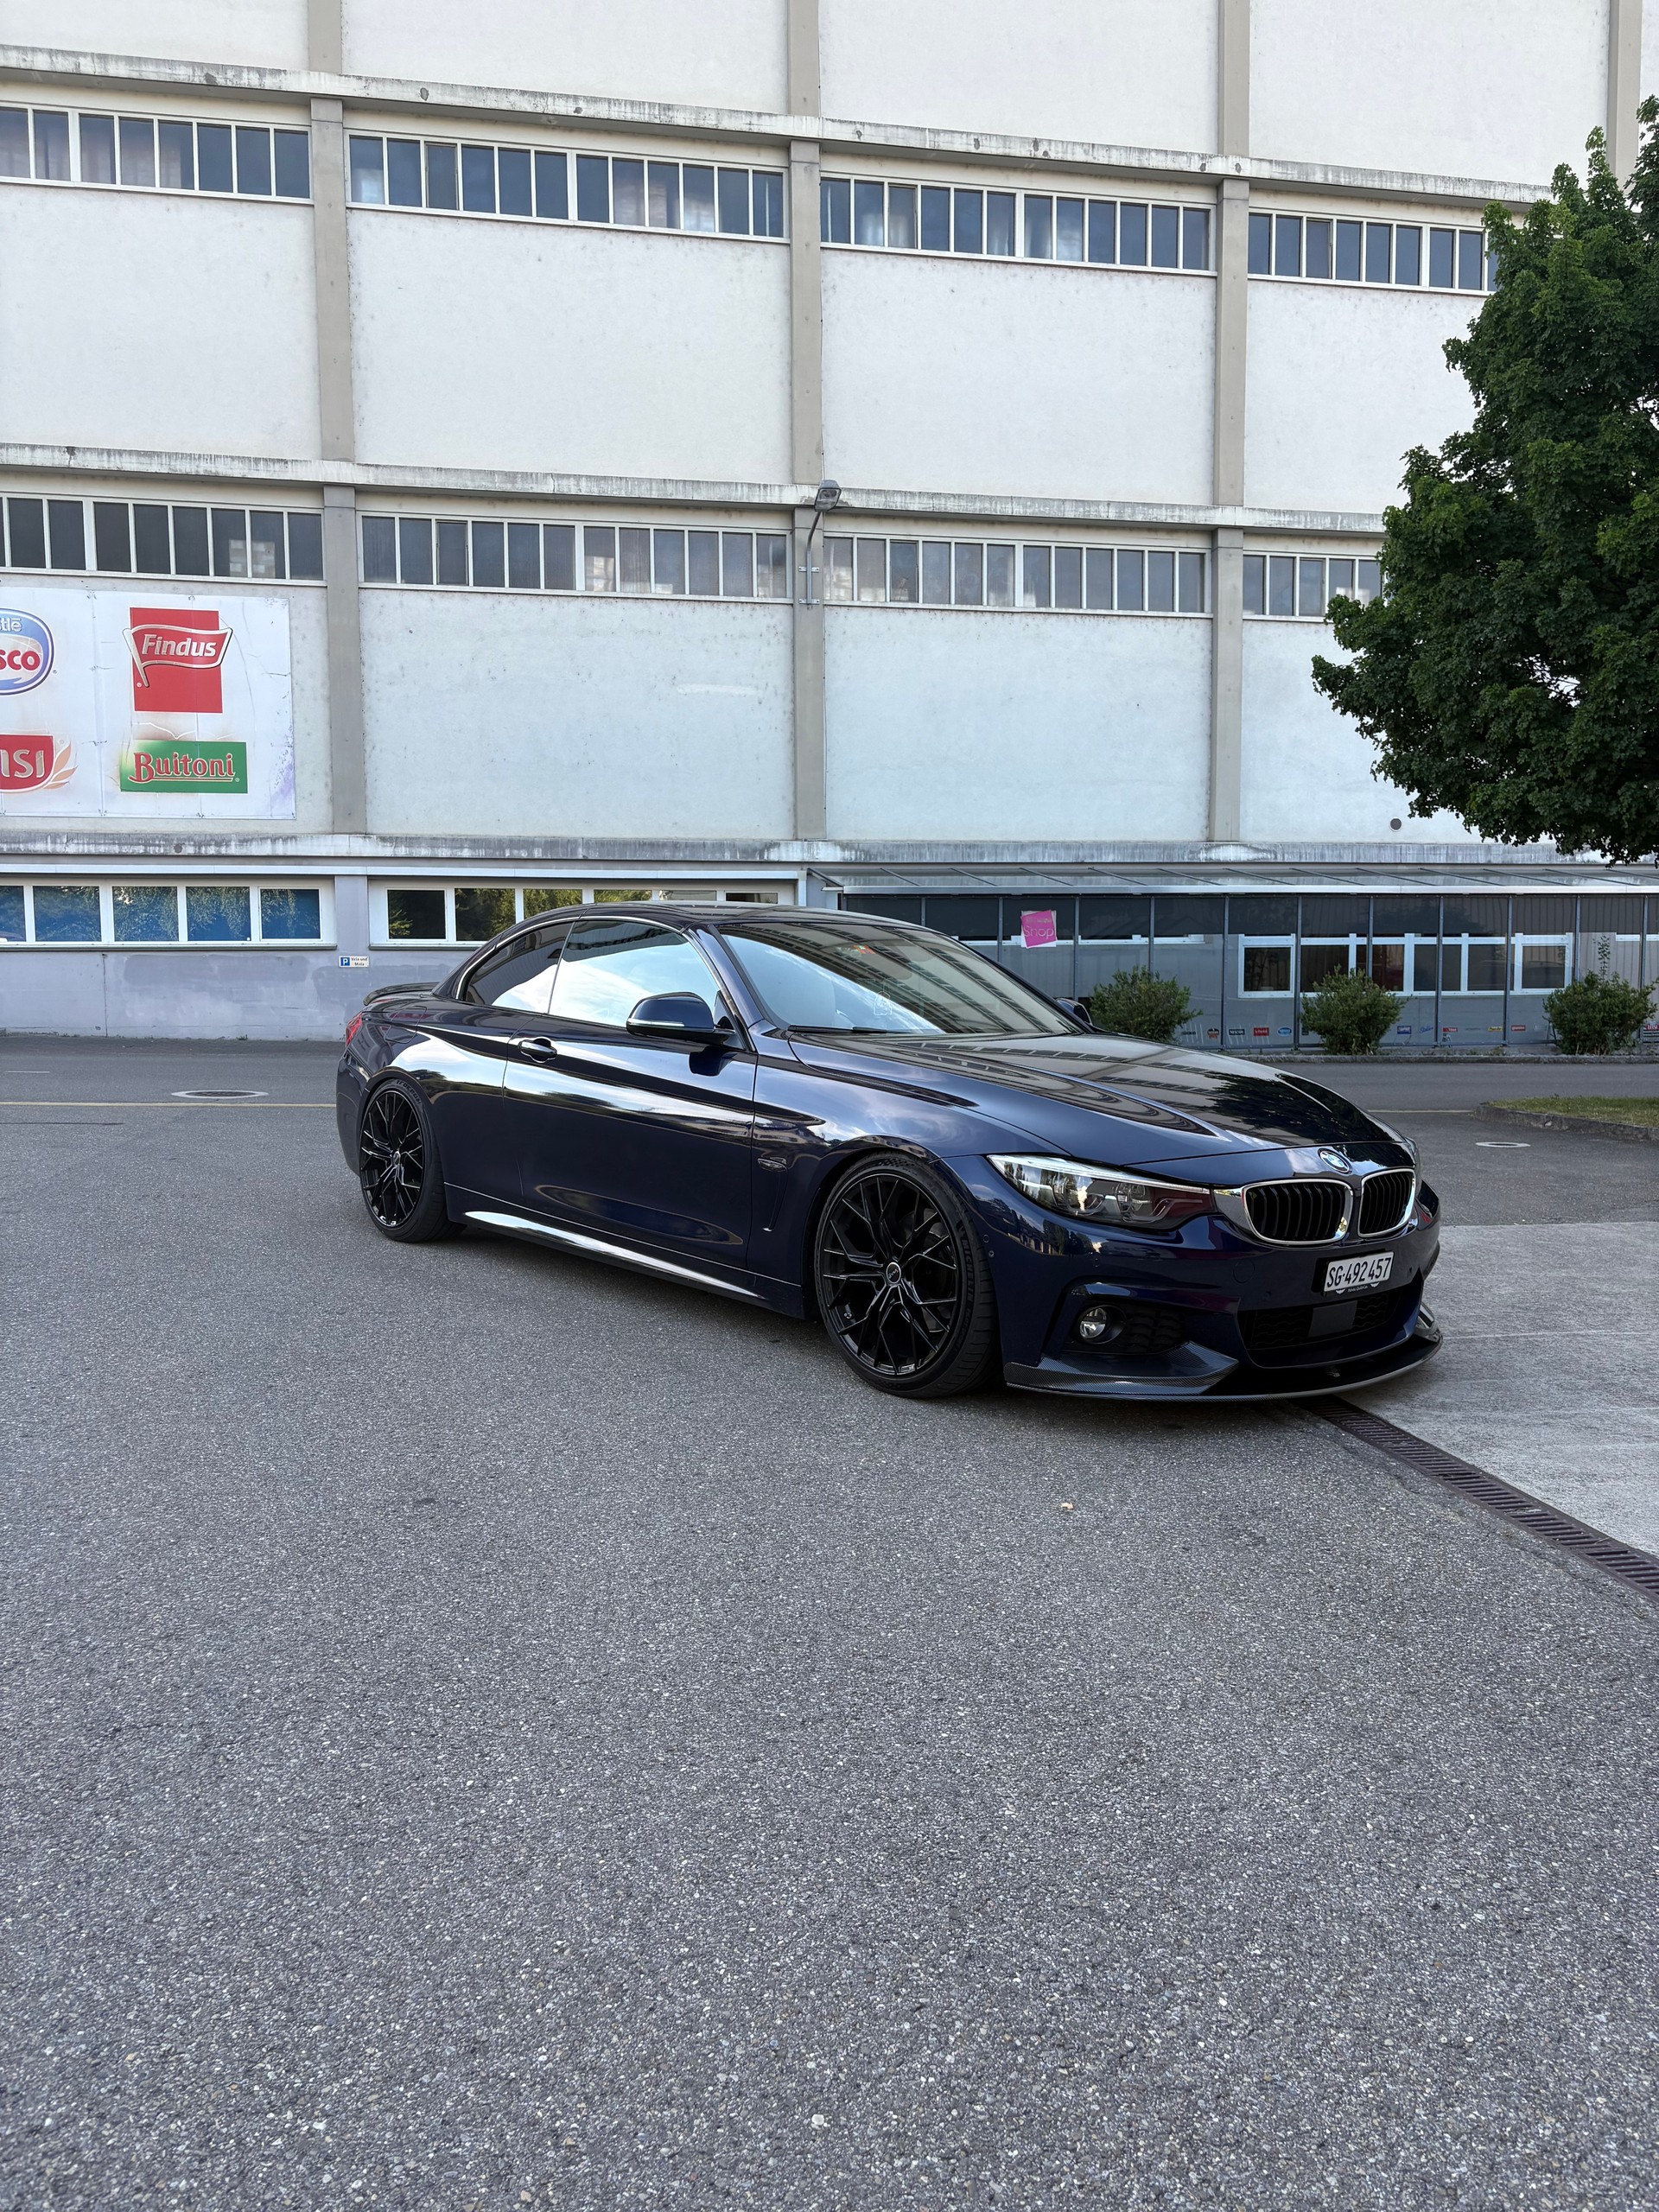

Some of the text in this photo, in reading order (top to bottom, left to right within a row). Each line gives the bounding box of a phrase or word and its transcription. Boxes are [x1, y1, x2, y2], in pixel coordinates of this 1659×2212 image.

[142, 633, 217, 657] Findus
[128, 751, 236, 783] Buitoni
[1023, 925, 1054, 940] Shop
